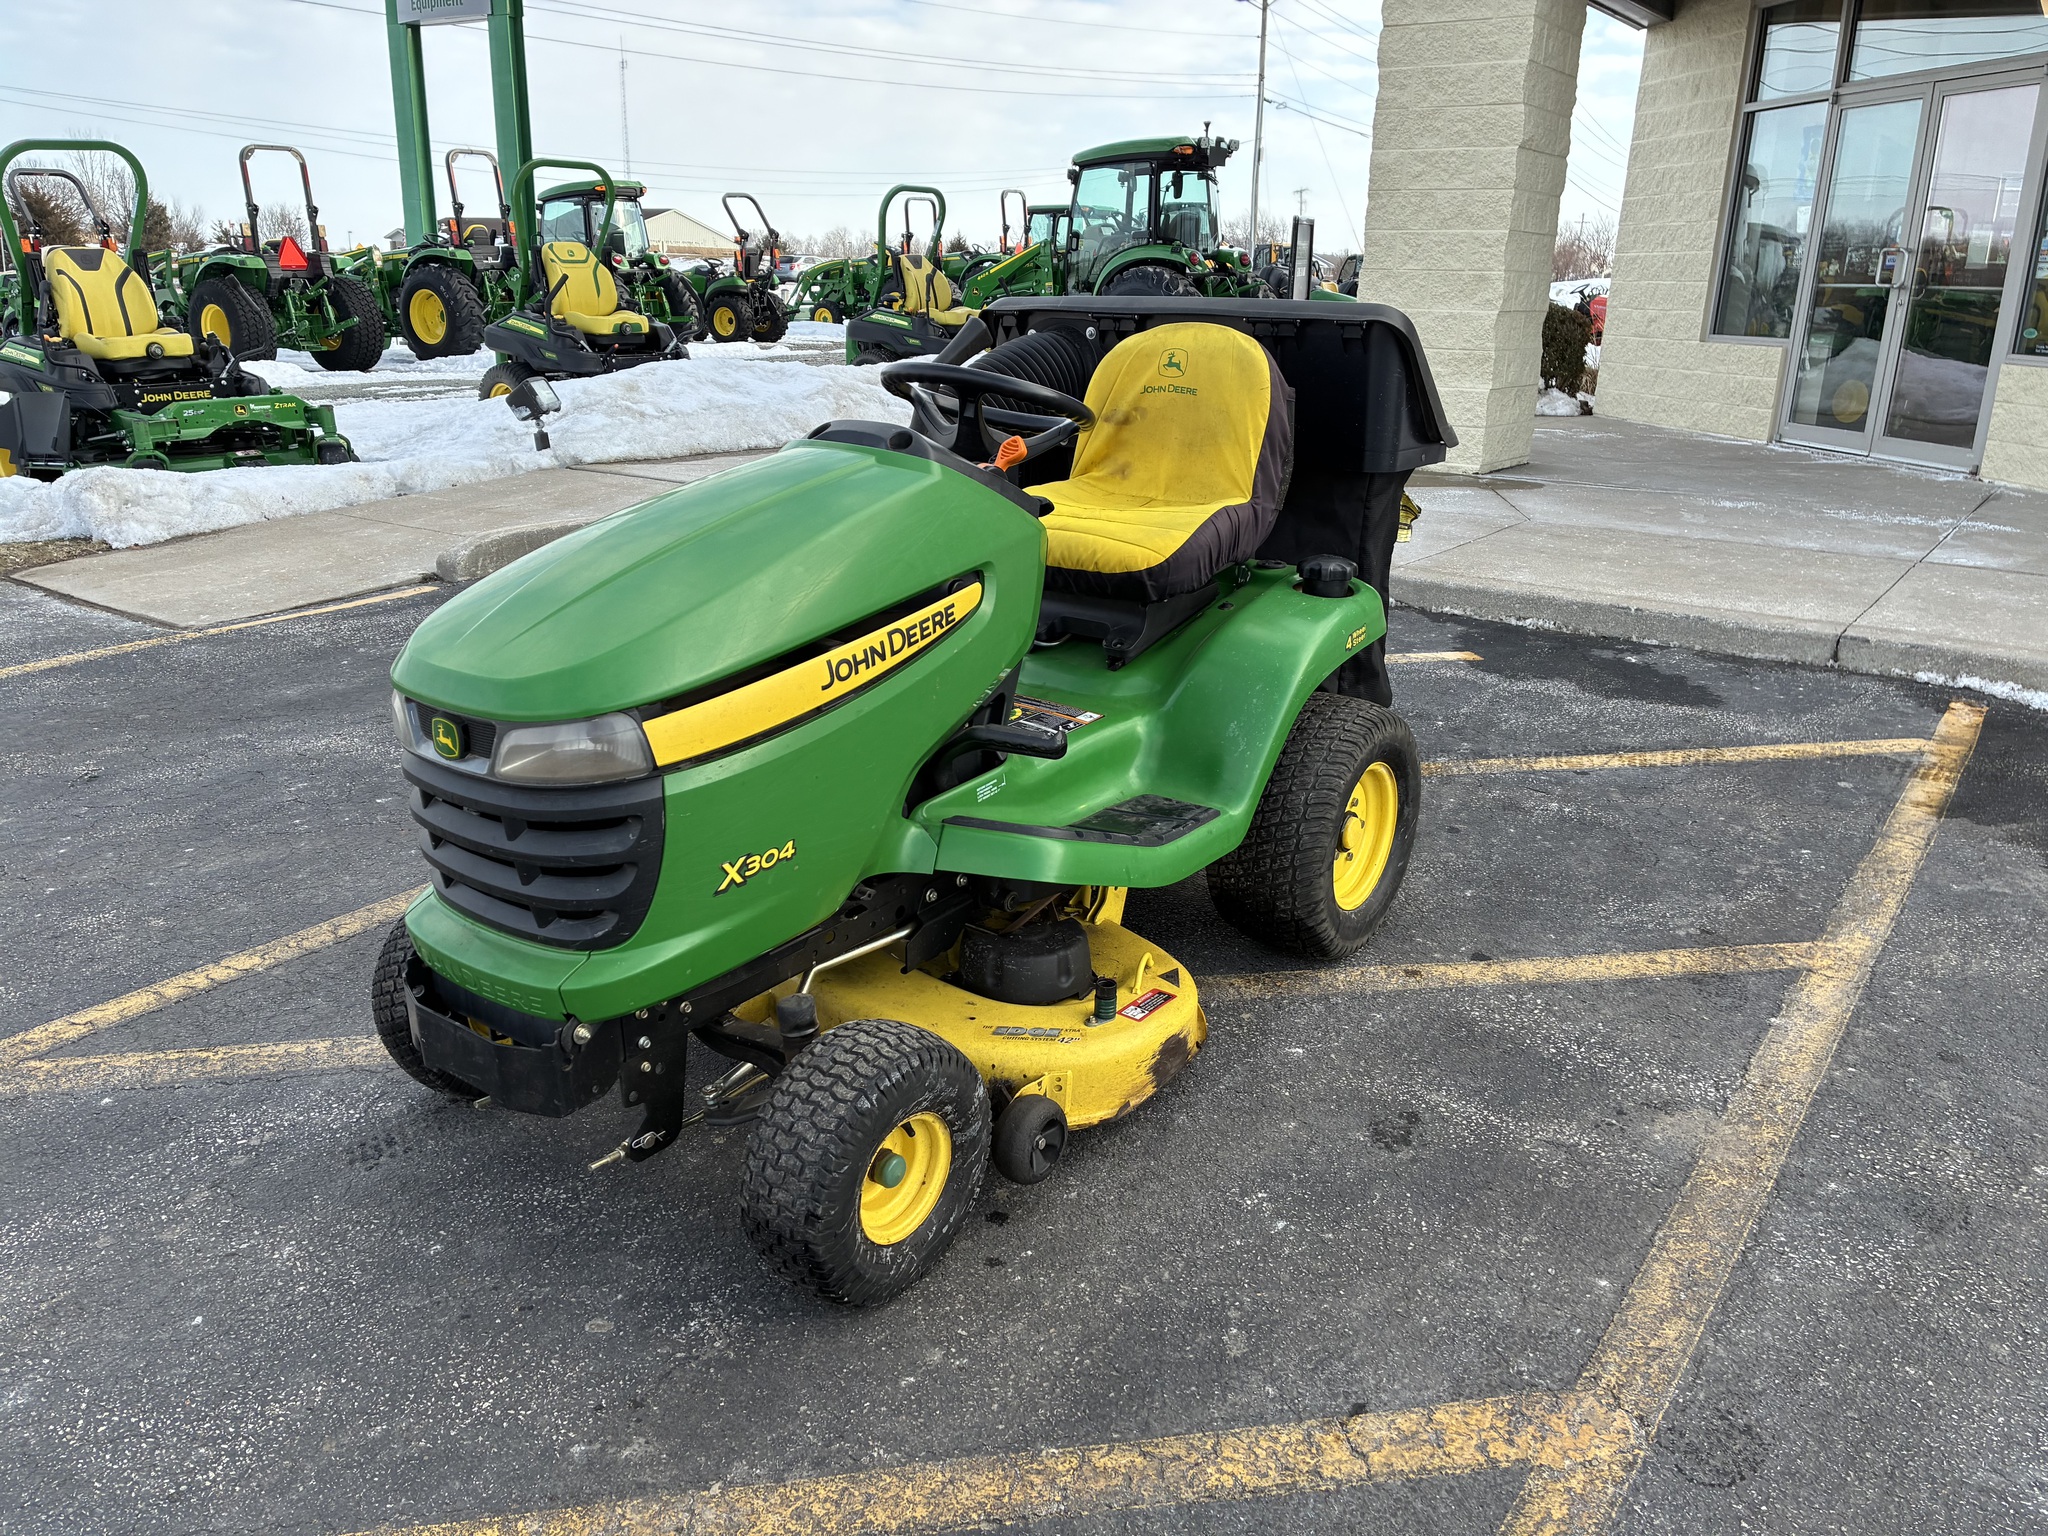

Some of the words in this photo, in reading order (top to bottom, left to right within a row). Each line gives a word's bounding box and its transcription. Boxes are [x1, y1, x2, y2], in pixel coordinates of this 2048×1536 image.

[141, 393, 172, 403] JOHN
[173, 389, 212, 401] DEERE
[1140, 384, 1167, 395] JOHN
[1168, 383, 1198, 396] DEERE
[821, 640, 887, 692] JOHN
[887, 603, 957, 658] DEERE
[1345, 634, 1352, 650] 4
[714, 838, 797, 897] X304
[991, 1025, 1062, 1037] EDGE
